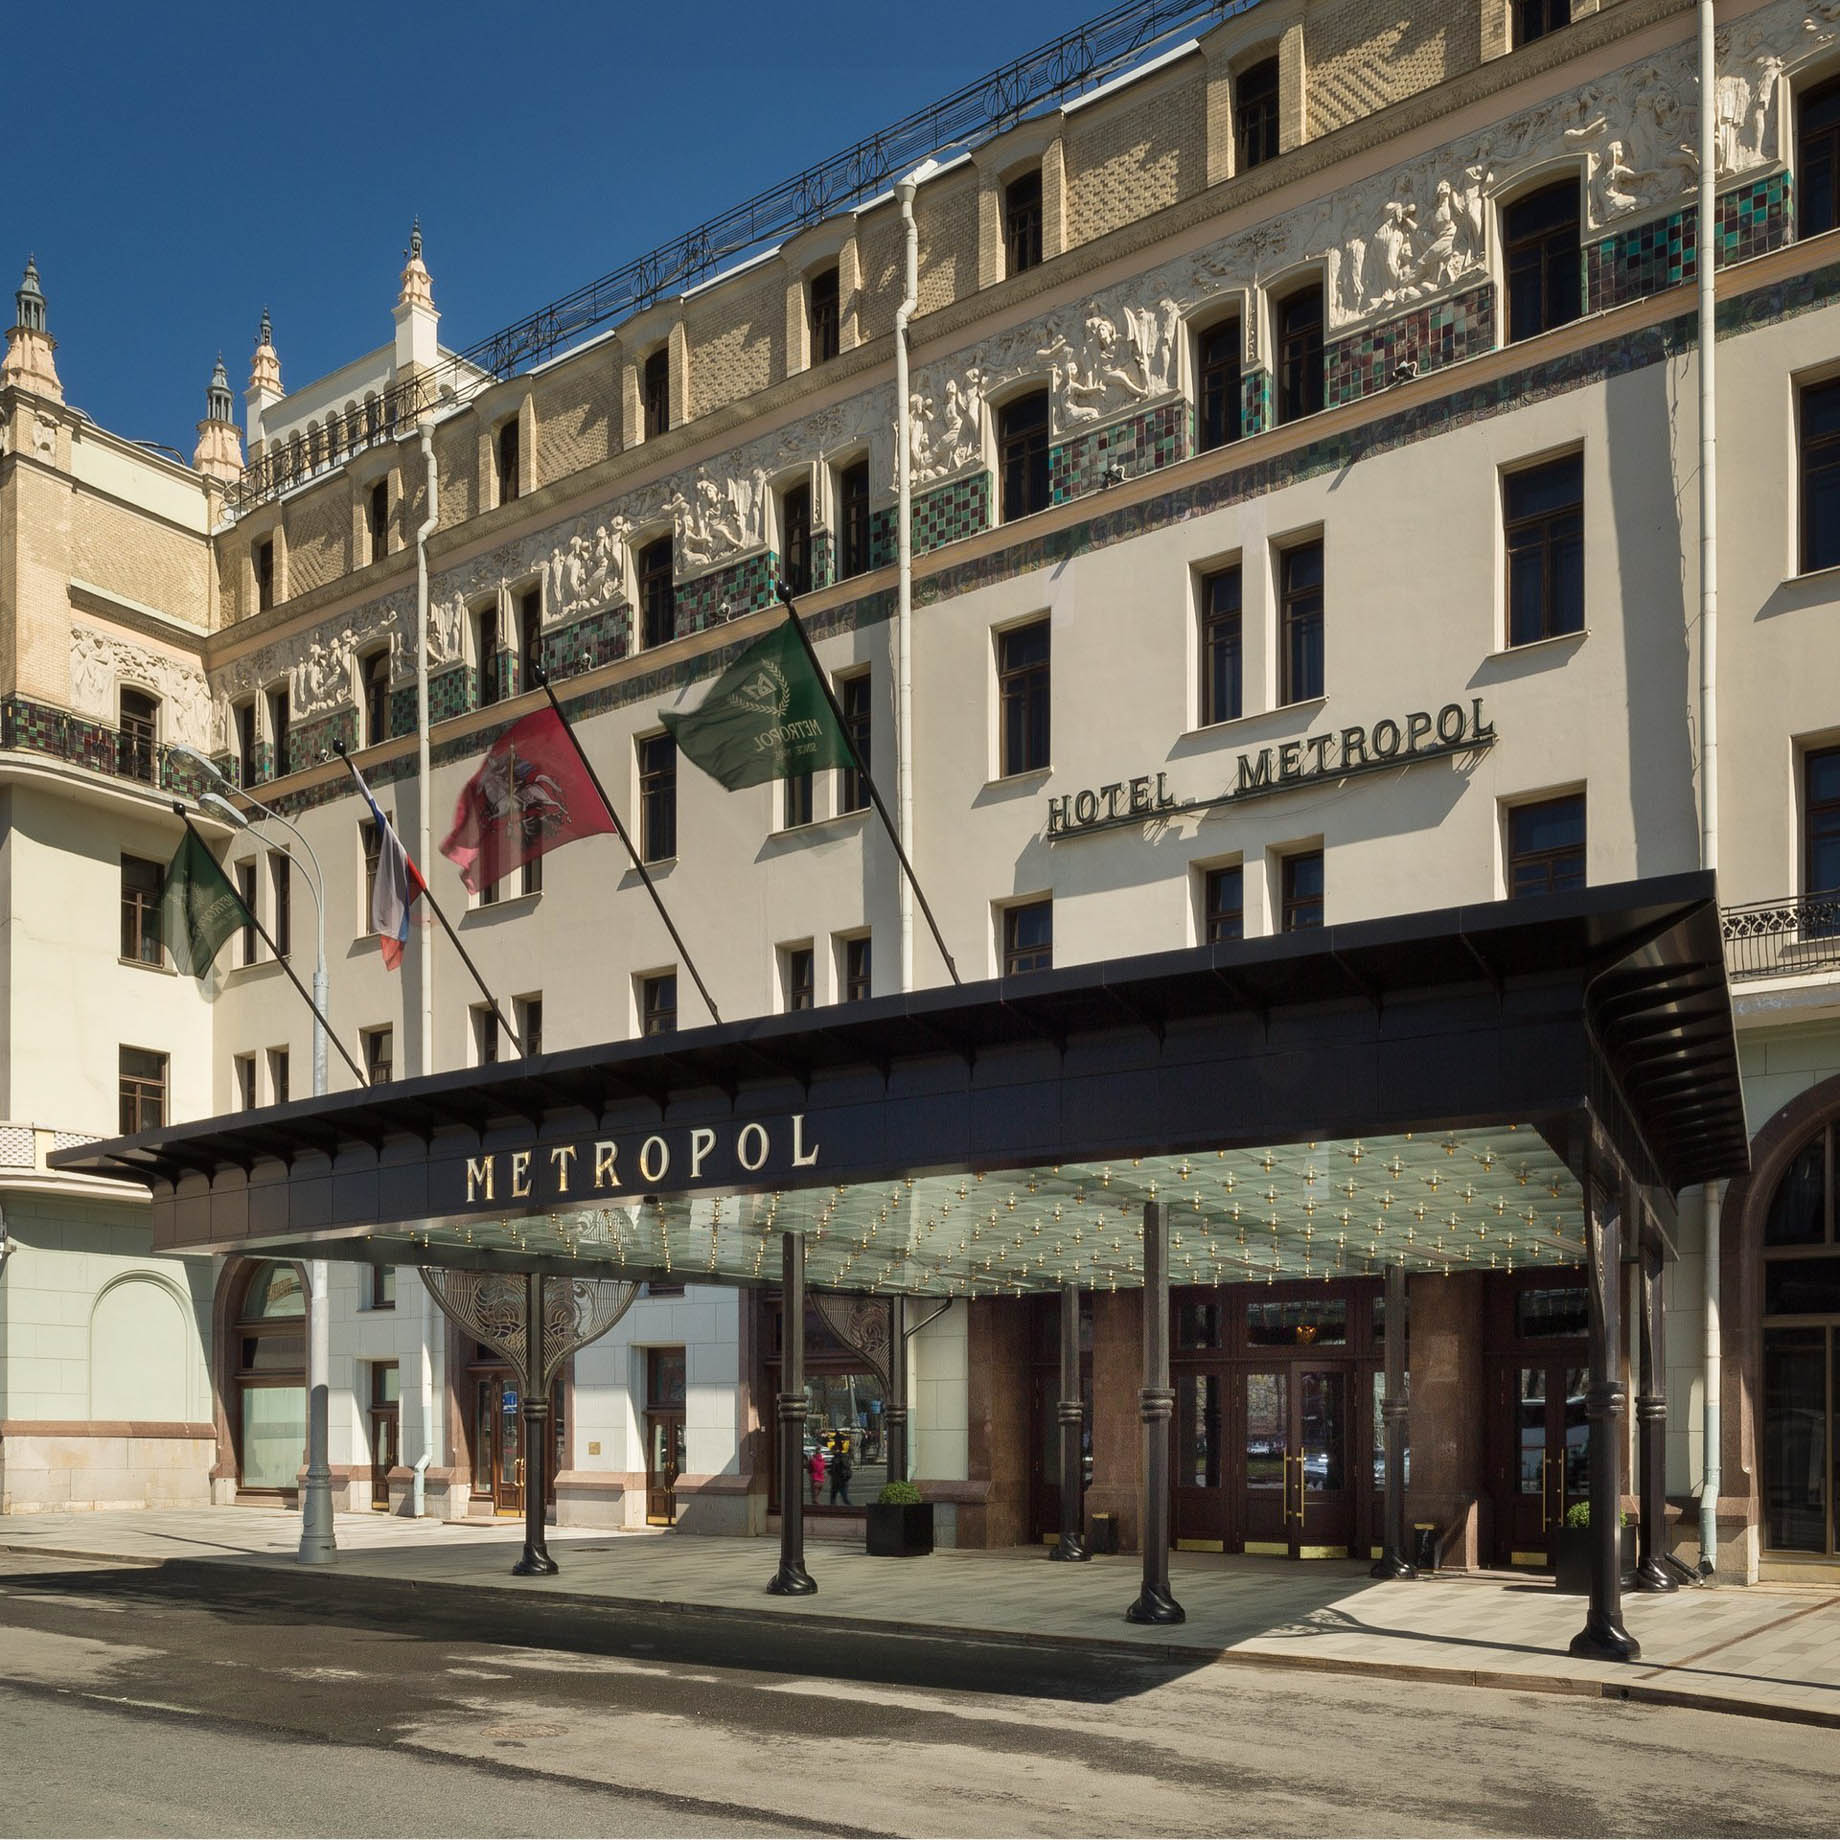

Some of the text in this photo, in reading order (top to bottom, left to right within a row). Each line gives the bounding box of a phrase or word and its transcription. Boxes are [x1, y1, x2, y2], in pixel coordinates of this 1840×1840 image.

[1048, 697, 1496, 832] HOTEL METROPOL
[466, 1114, 820, 1202] METROPOL
